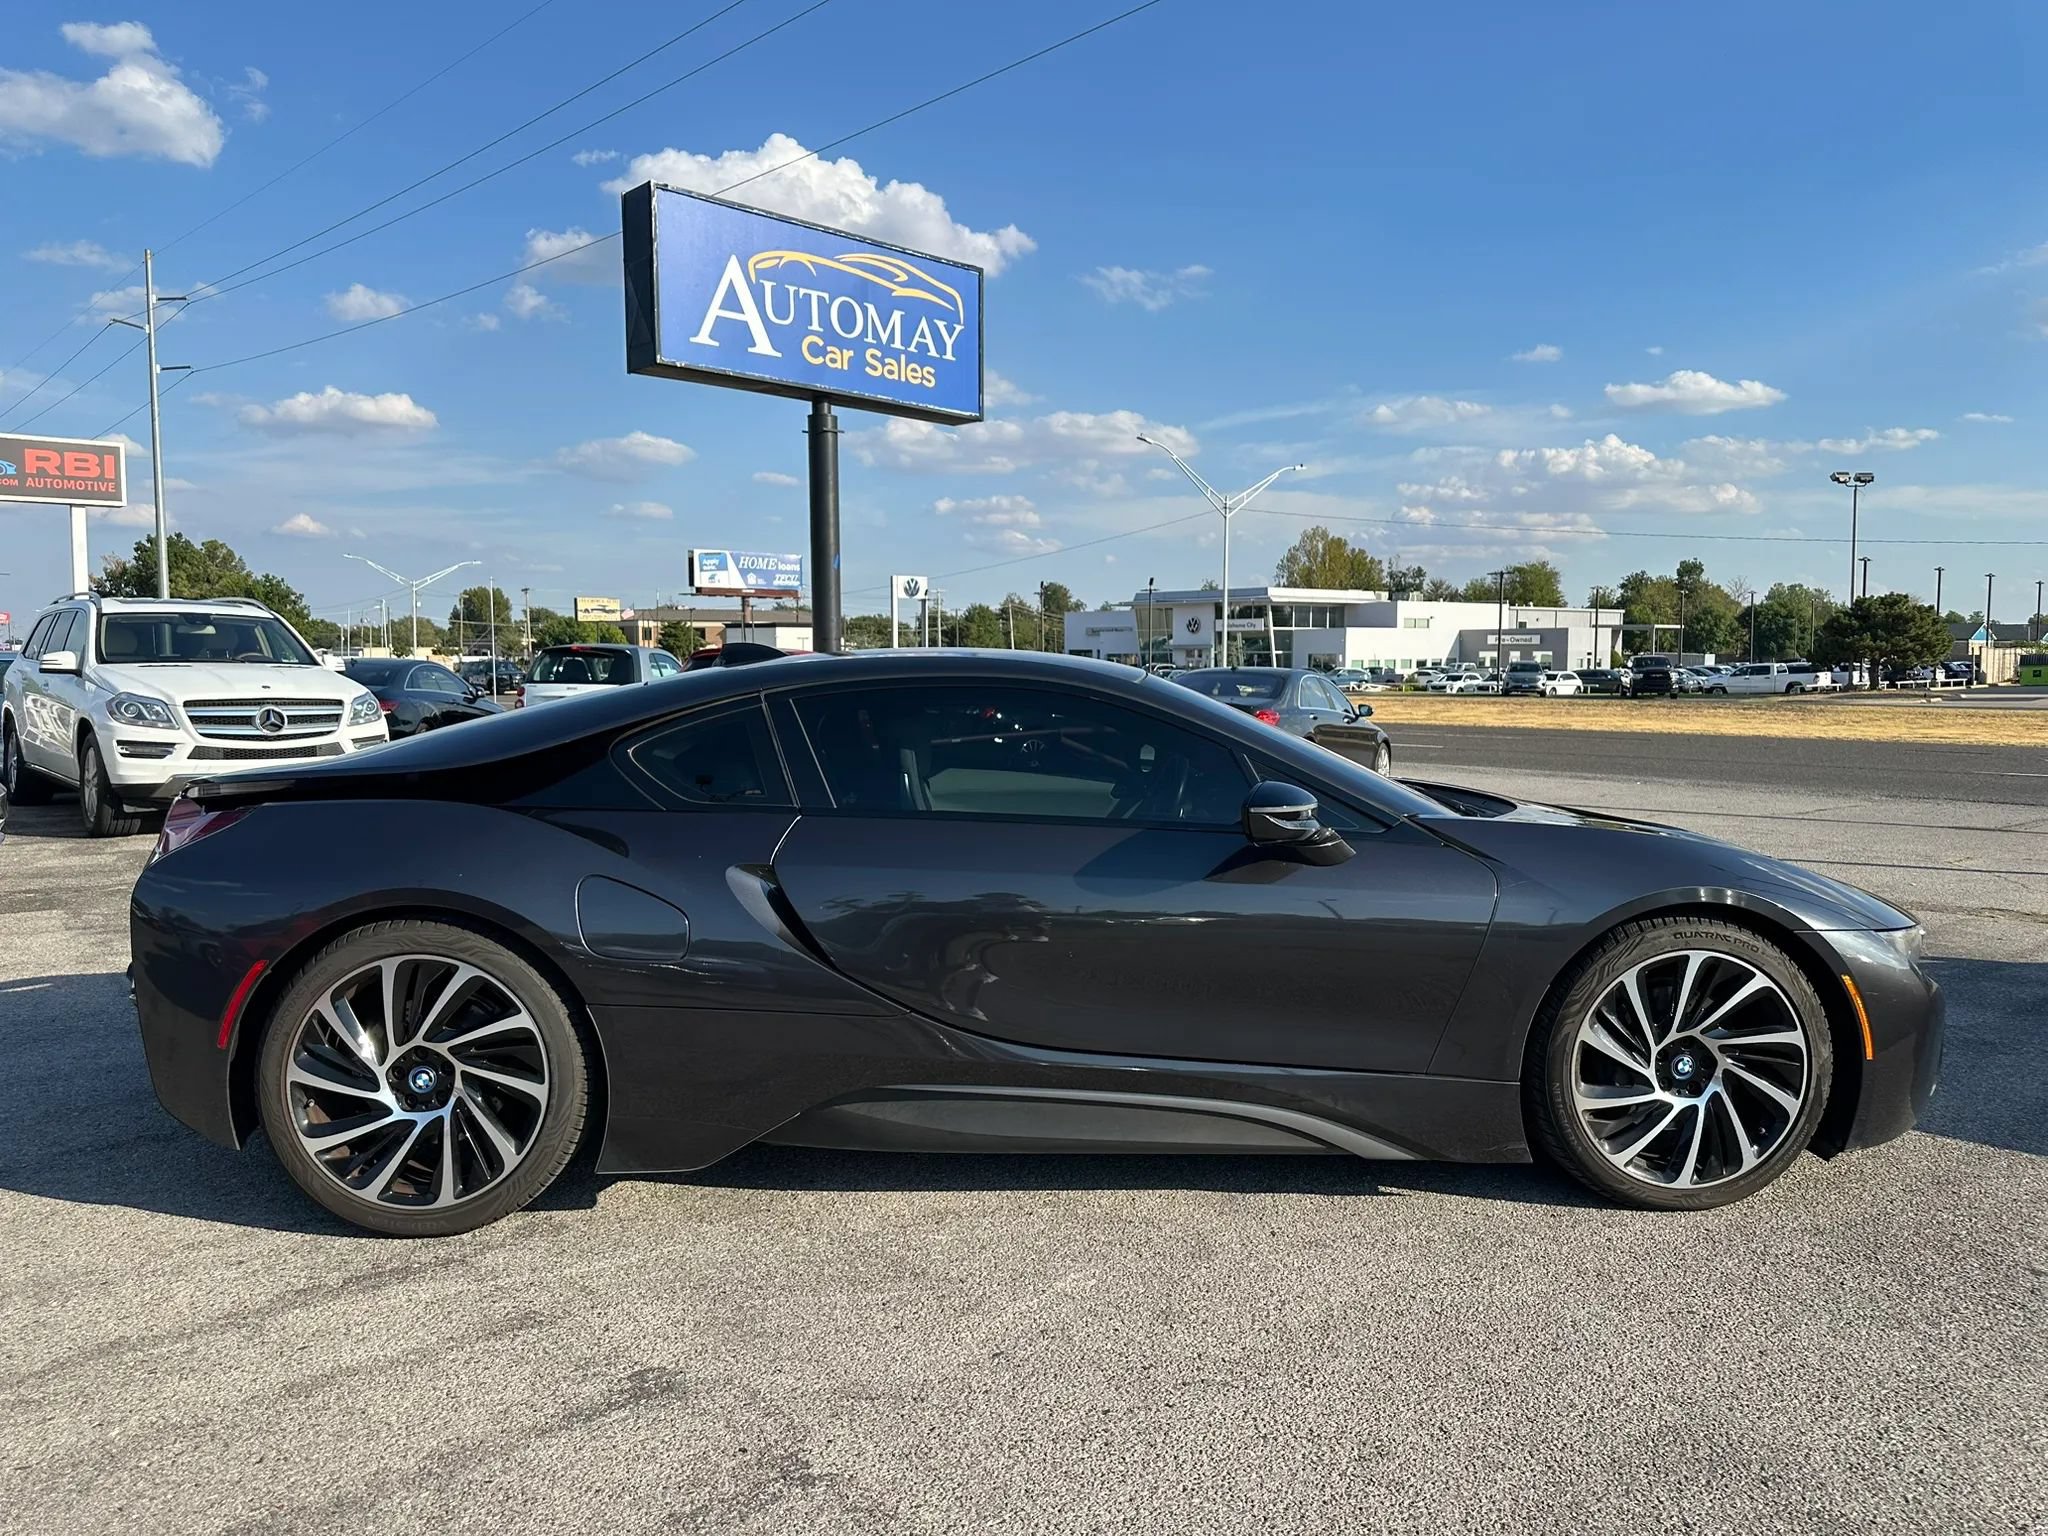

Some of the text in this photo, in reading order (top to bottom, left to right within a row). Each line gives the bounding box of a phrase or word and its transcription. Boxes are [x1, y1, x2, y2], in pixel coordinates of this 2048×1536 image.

[689, 255, 965, 361] AUTOMAY
[801, 335, 936, 388] Car Sales
[25, 448, 115, 479] RBI
[26, 477, 116, 492] AUTOMOTIVE
[738, 556, 777, 570] HOME
[1673, 931, 1760, 953] QUATRAC PRO
